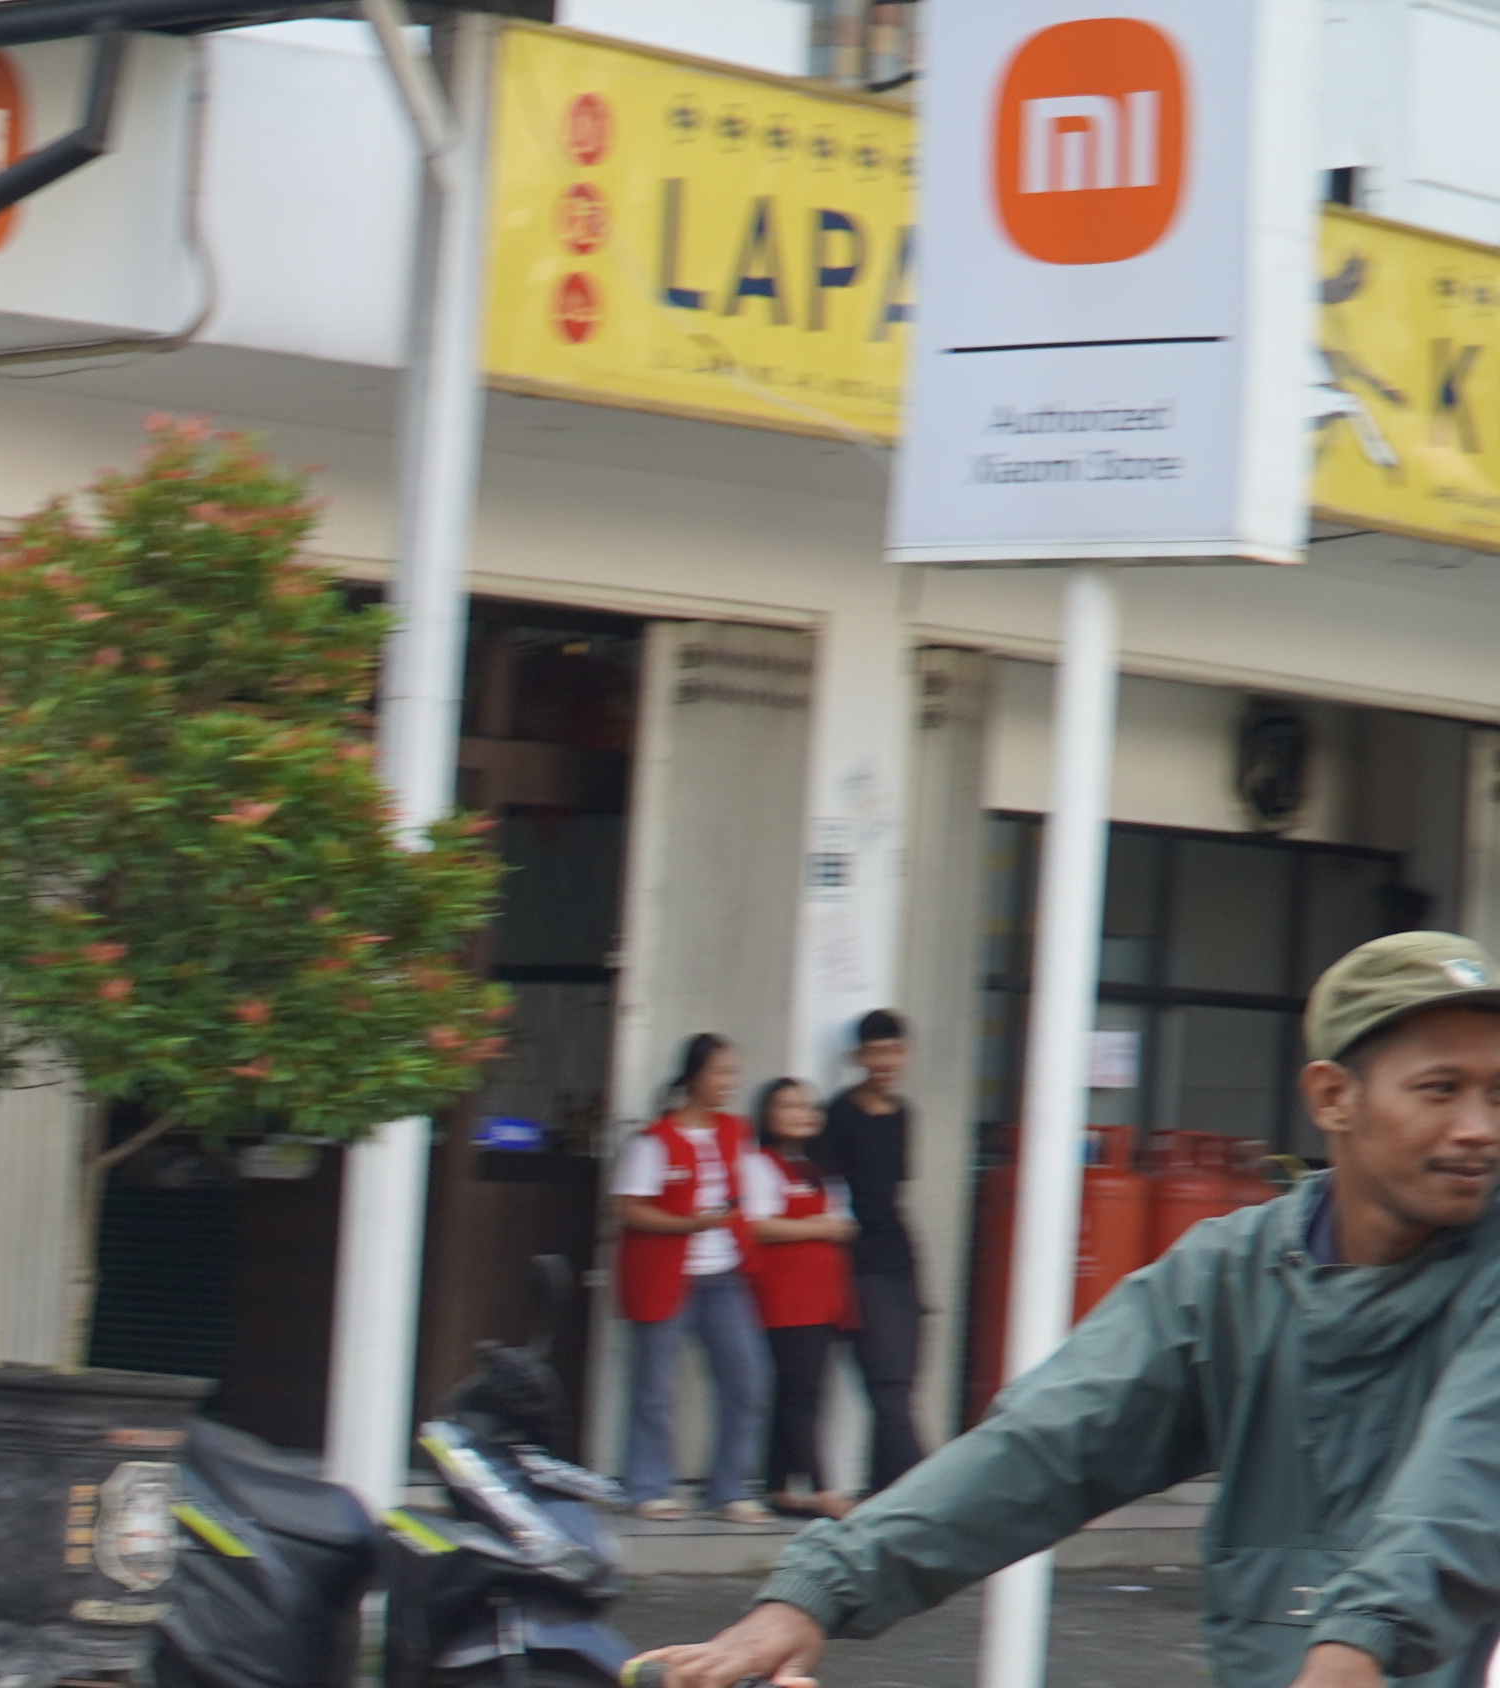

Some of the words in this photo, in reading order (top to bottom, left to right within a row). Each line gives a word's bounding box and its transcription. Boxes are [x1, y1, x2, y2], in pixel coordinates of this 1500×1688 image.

[984, 398, 1176, 434] Authorized
[967, 451, 1081, 485] Xiaomi
[1086, 448, 1182, 481] Store
